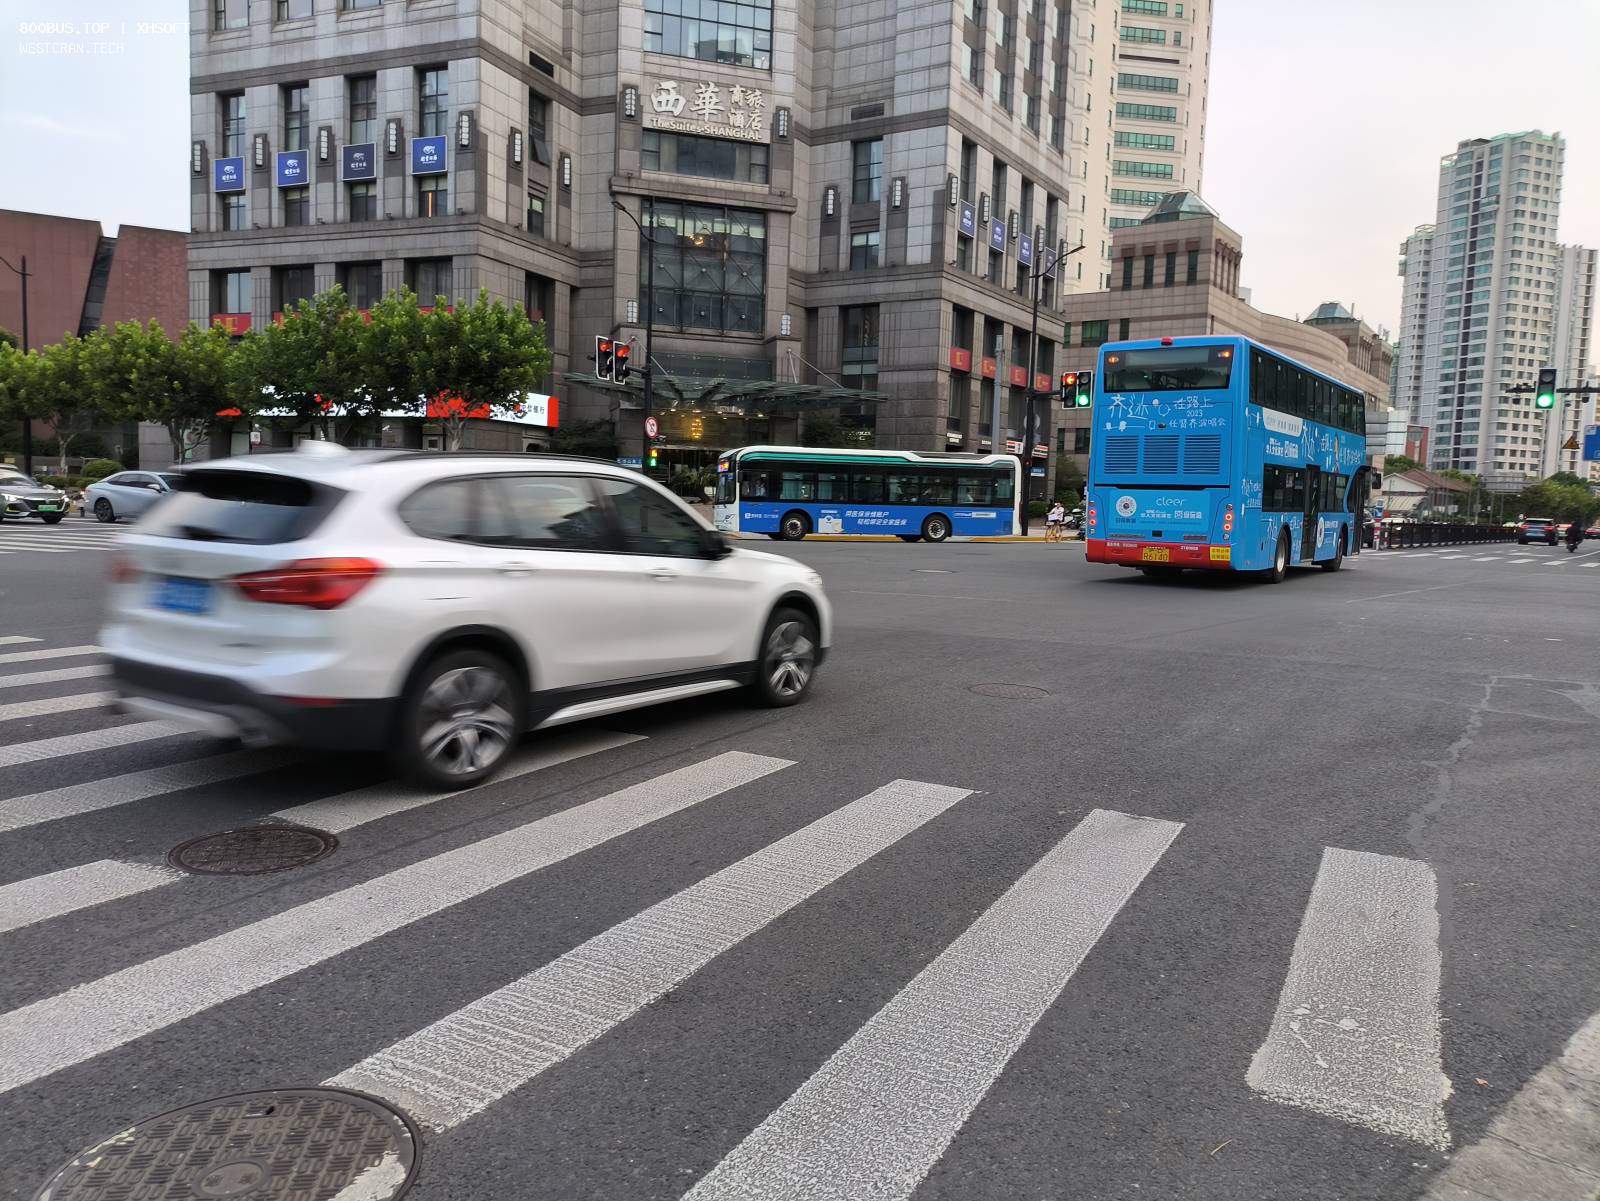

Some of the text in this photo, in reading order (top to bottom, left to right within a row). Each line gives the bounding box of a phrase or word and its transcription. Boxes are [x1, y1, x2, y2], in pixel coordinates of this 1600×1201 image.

[1173, 396, 1214, 409] 在路上
[1169, 418, 1226, 429] 任贤齐演唱会
